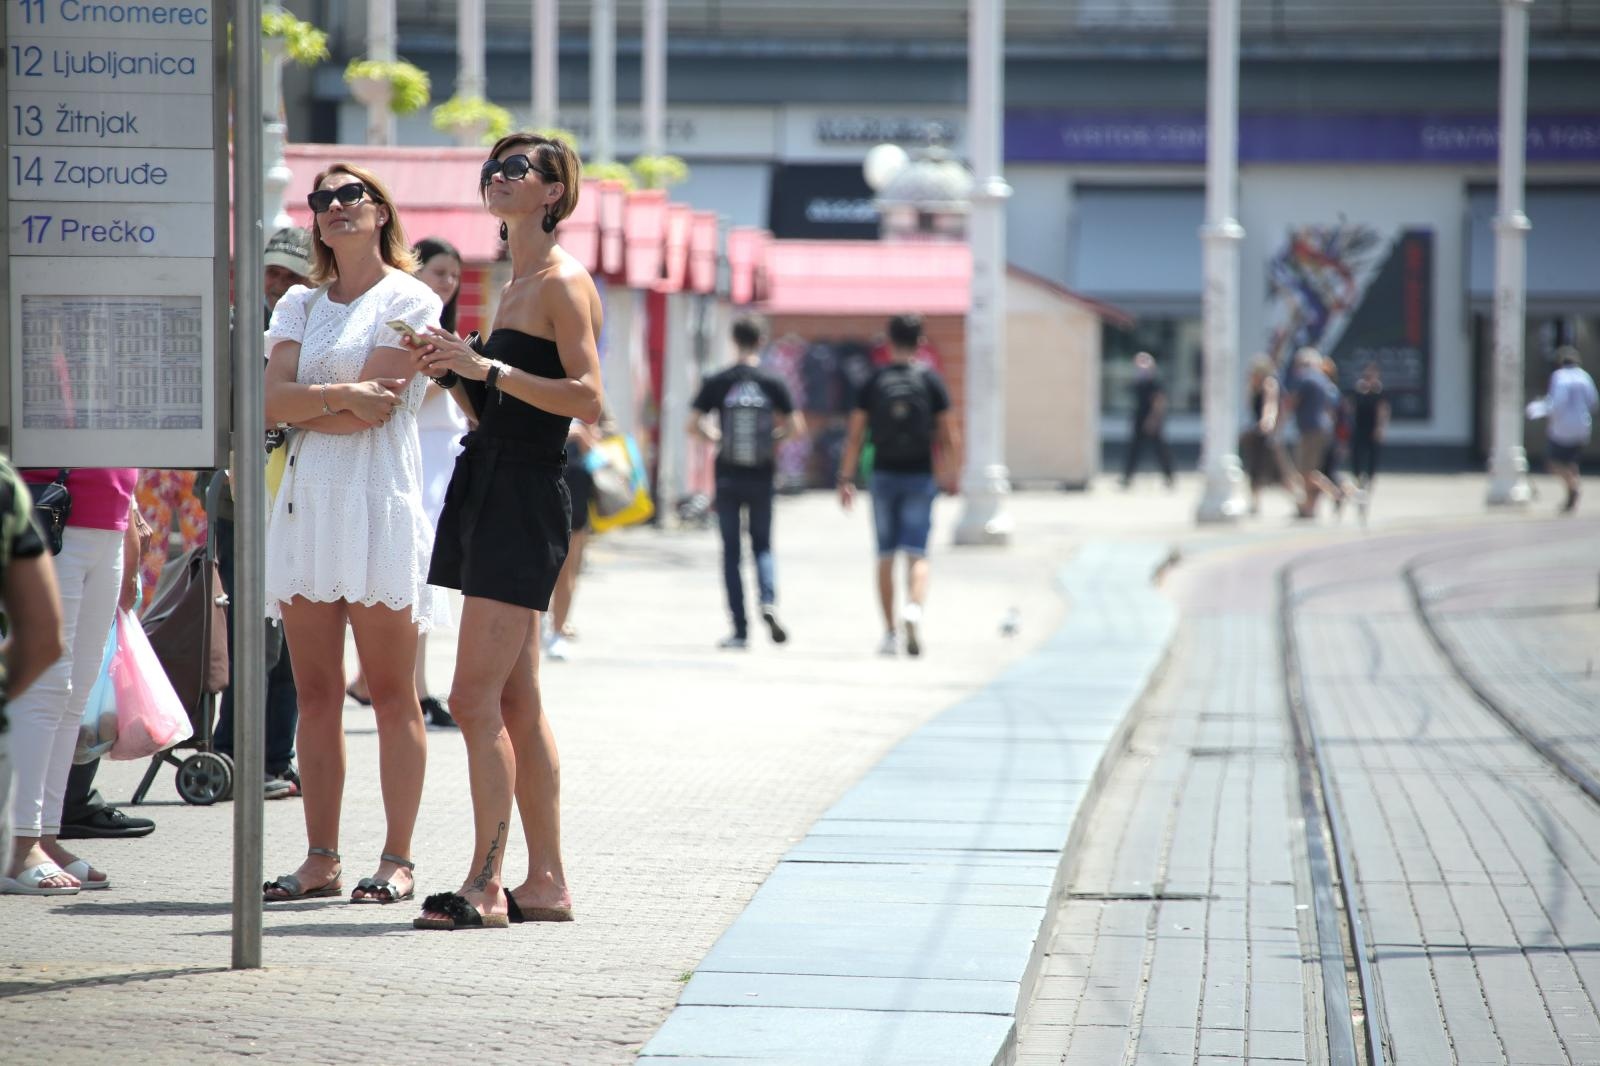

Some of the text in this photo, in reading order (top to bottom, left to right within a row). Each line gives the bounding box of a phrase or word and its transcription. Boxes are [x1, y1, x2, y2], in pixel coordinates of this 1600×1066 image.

[19, 0, 44, 24] 11
[11, 46, 195, 78] 12 Ljubljanica
[13, 103, 138, 138] 13 Žitnjak
[12, 156, 168, 188] 14 Zapruđe
[21, 215, 155, 244] 17 Prečko
